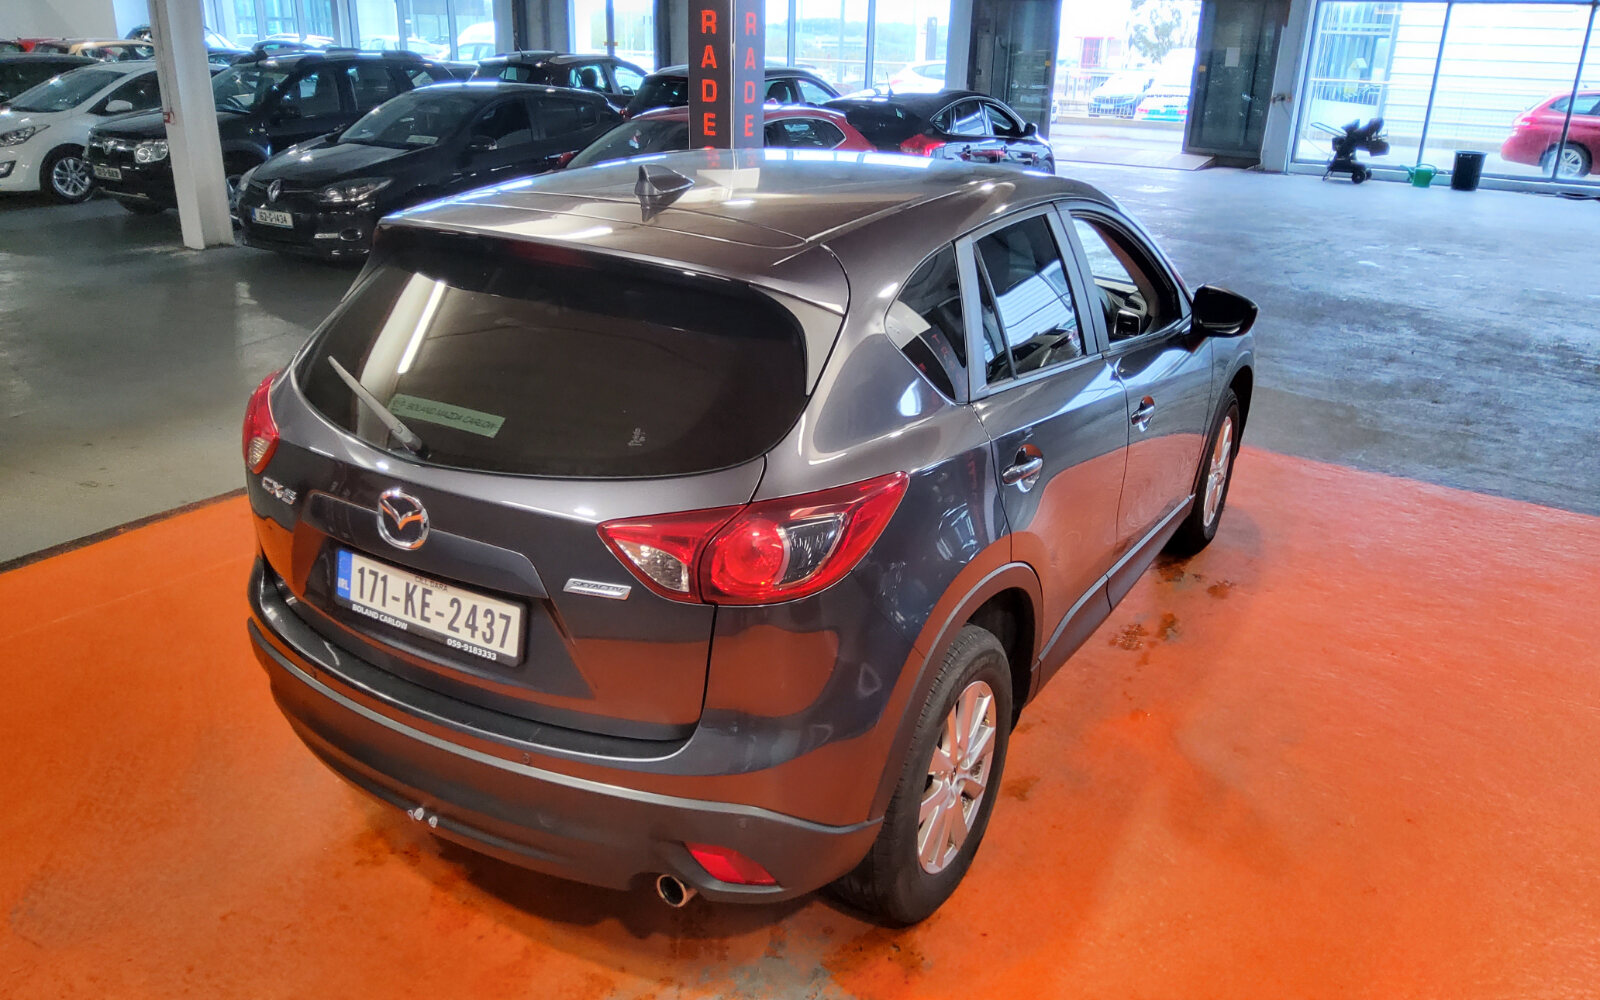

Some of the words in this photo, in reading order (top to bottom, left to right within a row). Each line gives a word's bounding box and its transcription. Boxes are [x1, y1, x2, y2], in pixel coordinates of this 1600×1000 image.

[701, 9, 718, 150] RADE
[744, 11, 757, 150] RADE
[437, 409, 463, 420] MAZDA
[337, 576, 350, 591] IRL
[352, 603, 379, 619] BOLAND
[379, 613, 408, 630] CARLOW
[357, 566, 512, 649] 171-KE-2437
[446, 638, 497, 661] 059-9183333
